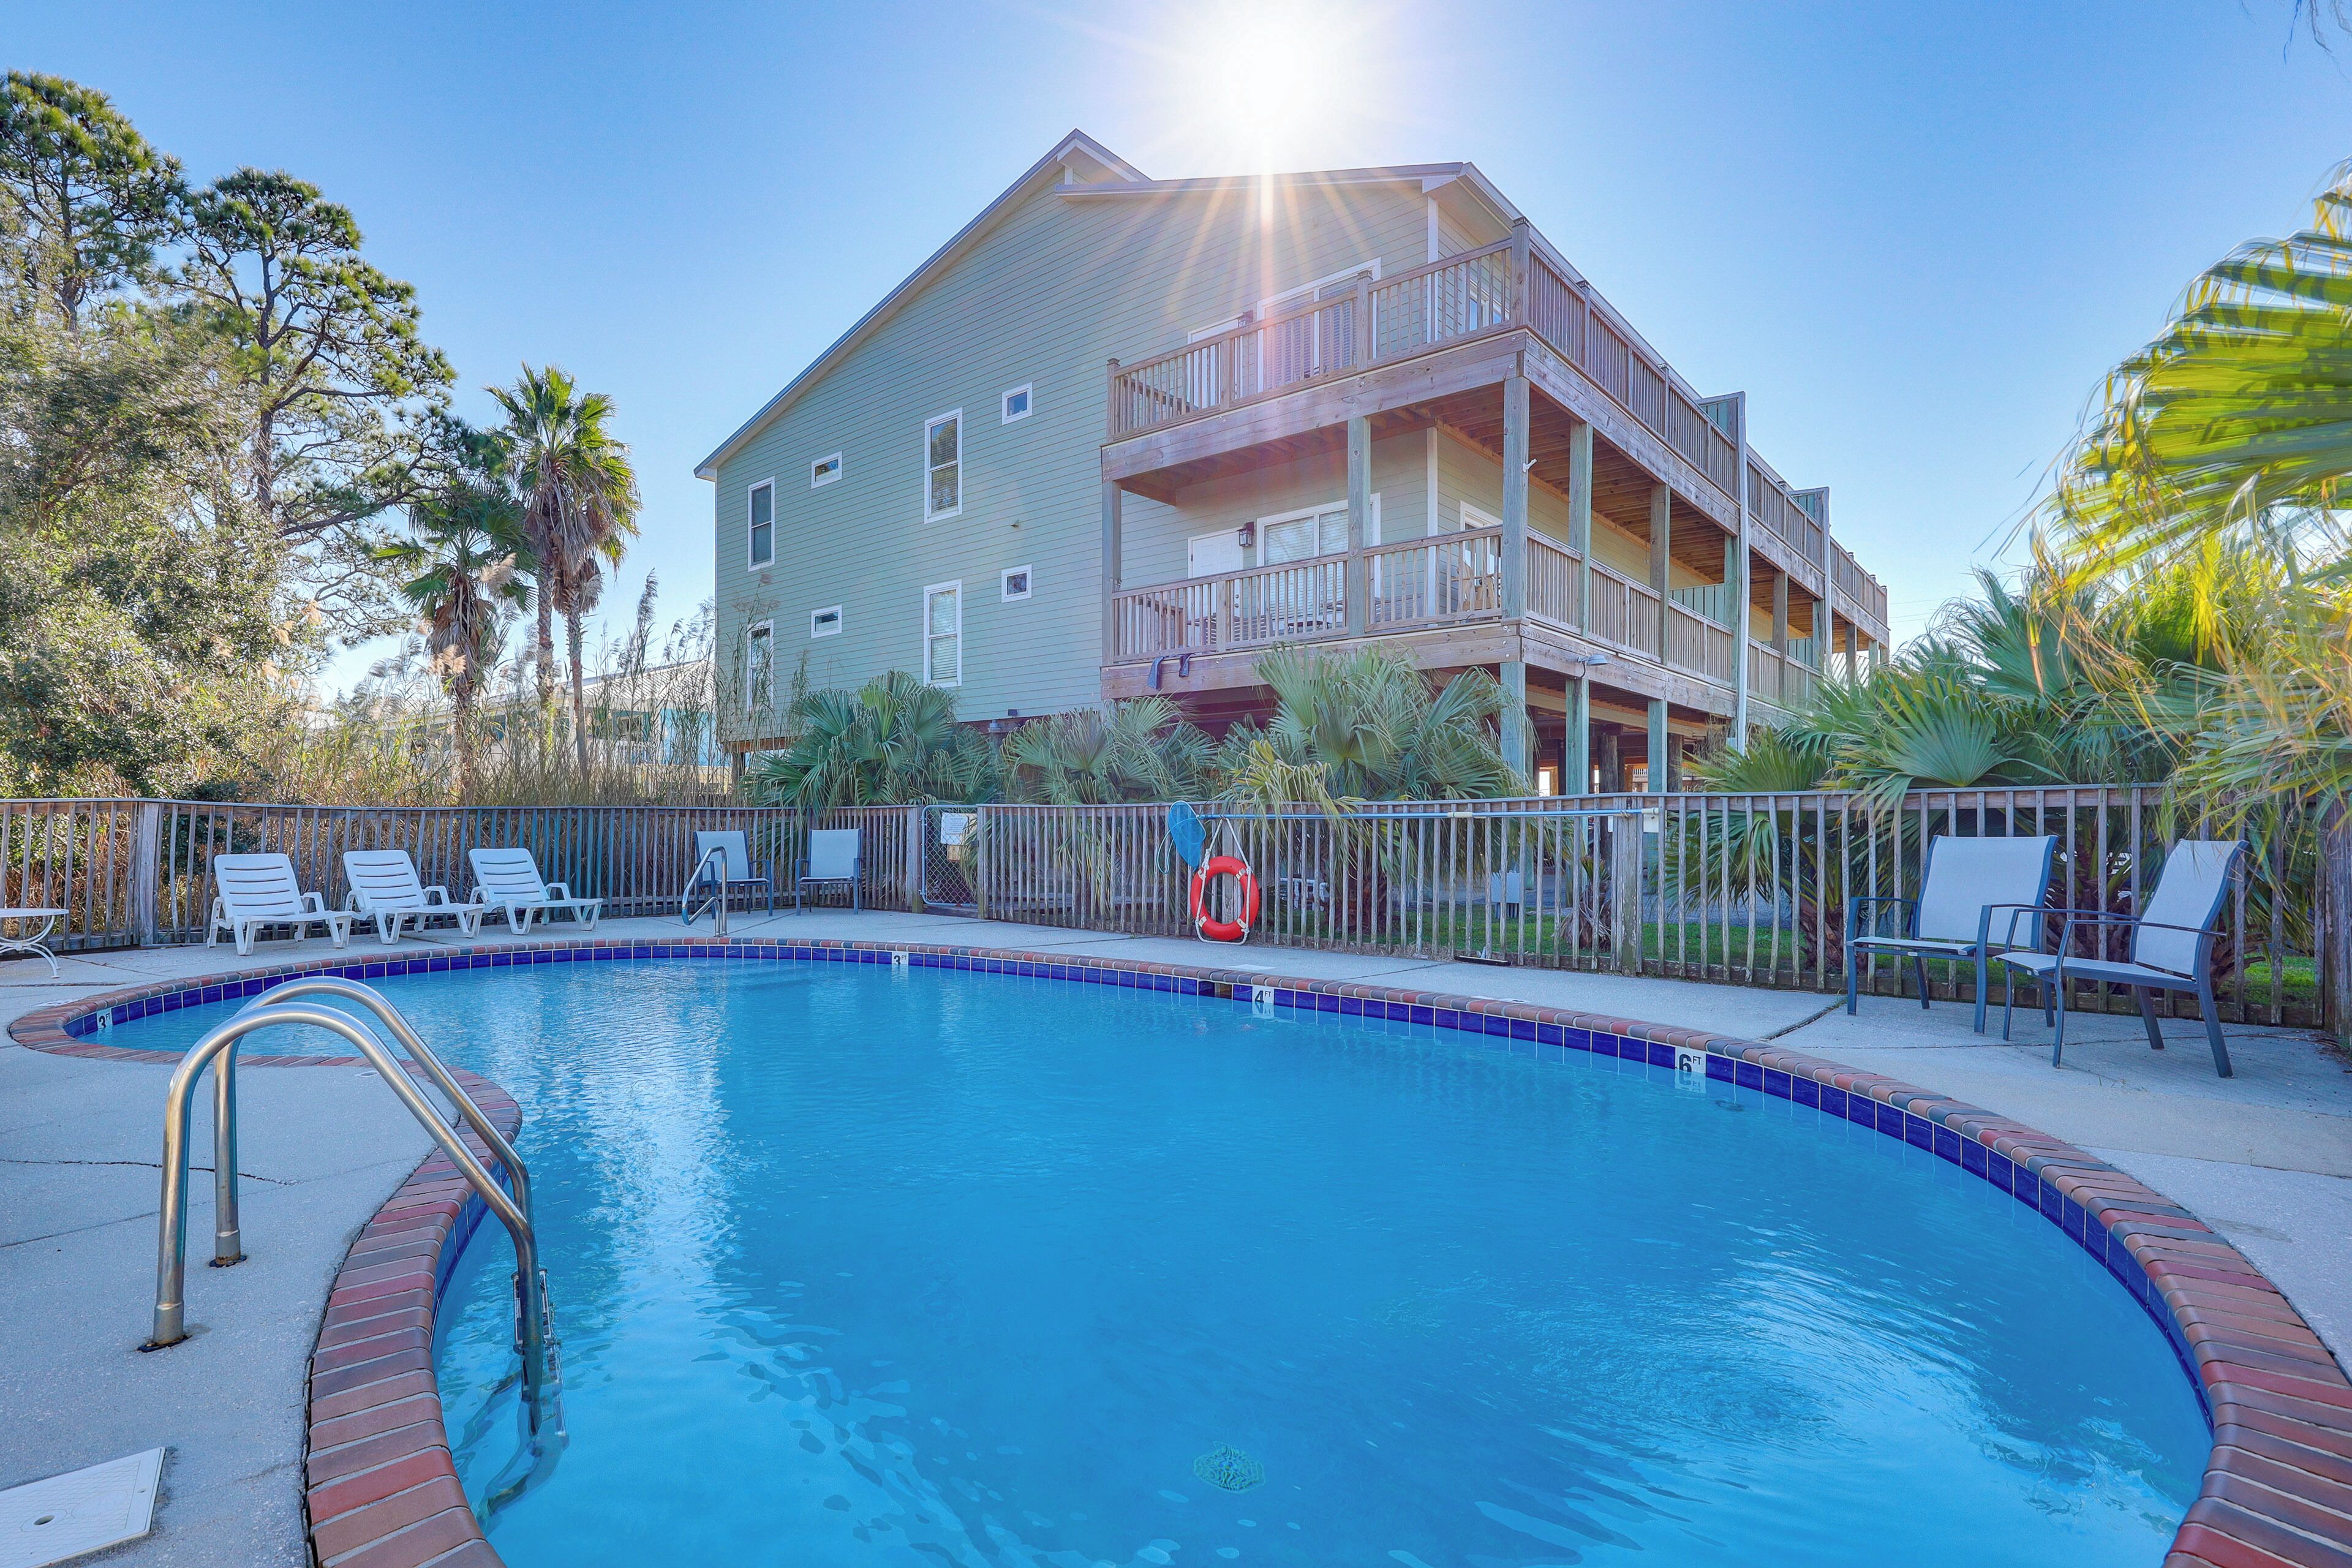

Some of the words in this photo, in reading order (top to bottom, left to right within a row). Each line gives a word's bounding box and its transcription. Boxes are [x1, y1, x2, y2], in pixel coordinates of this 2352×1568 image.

[893, 956, 901, 965] 3
[1254, 990, 1265, 1003] 4
[99, 1016, 106, 1028] 3
[1679, 1054, 1692, 1072] 6
[1692, 1055, 1702, 1065] FT
